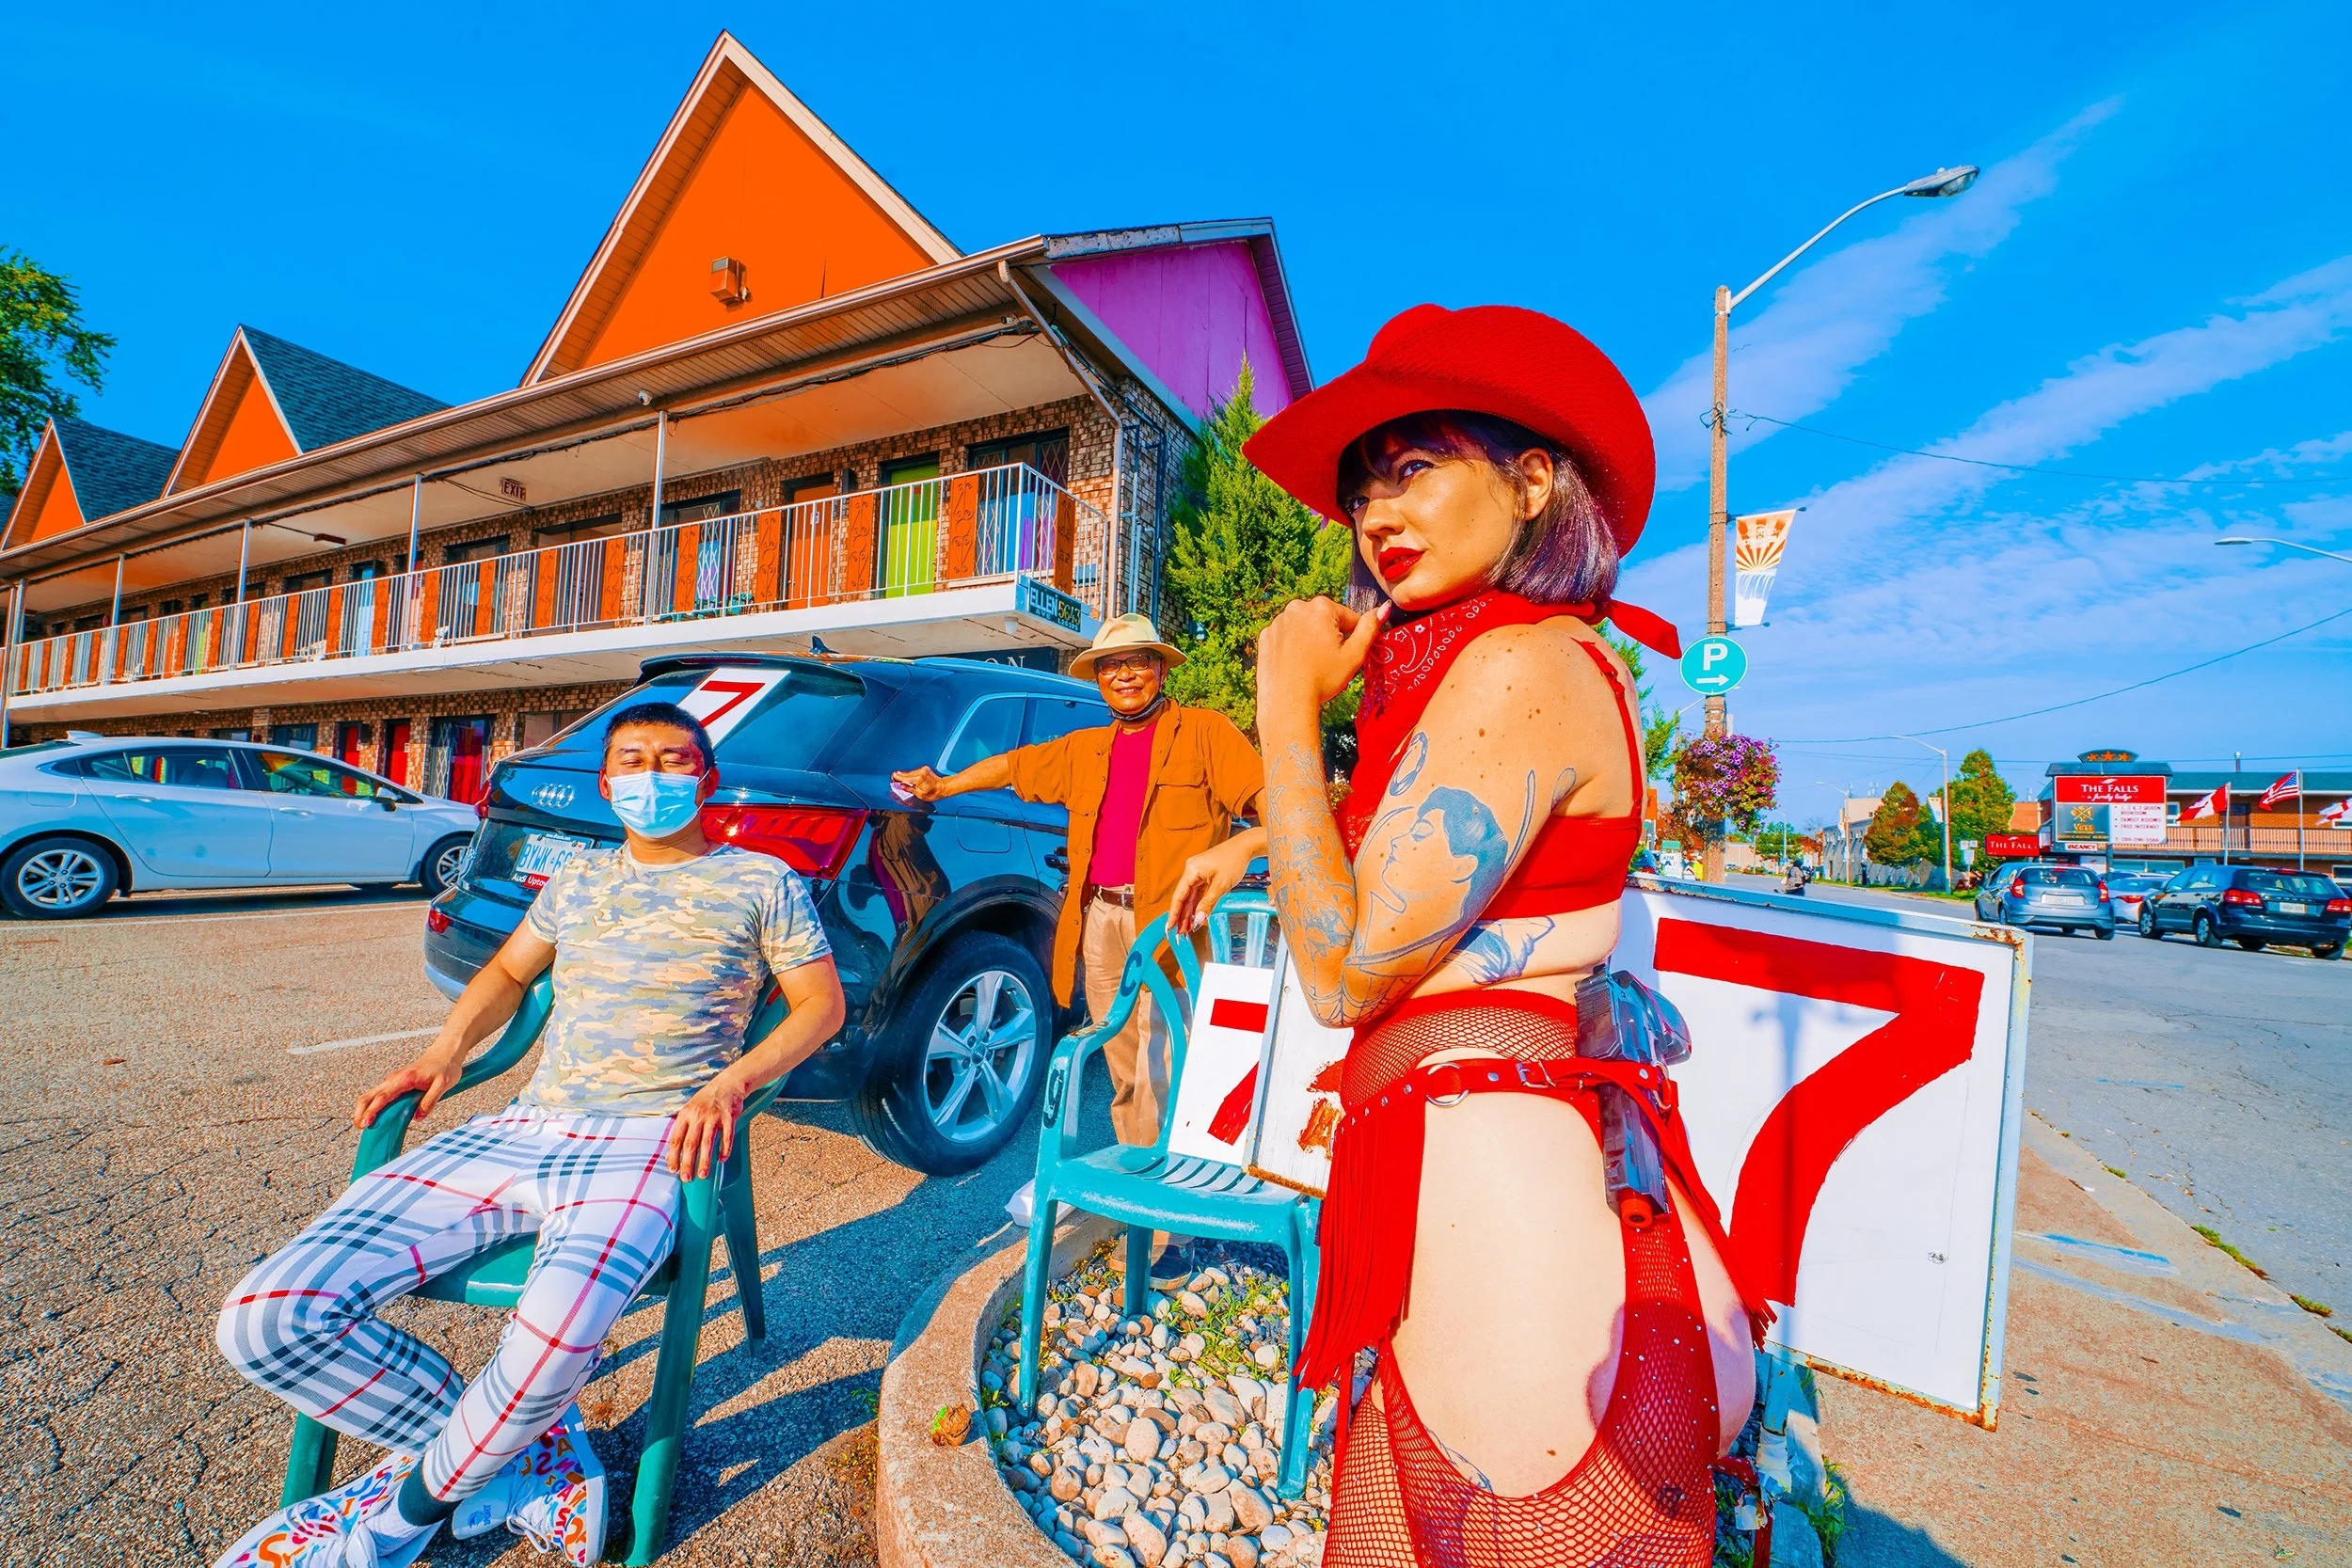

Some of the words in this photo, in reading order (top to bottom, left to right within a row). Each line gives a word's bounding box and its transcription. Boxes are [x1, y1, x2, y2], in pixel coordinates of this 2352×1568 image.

[504, 481, 525, 499] EXIT
[1030, 587, 1058, 617] ELLEN
[1058, 600, 1081, 626] 5643
[1035, 609, 1051, 620] AVE
[1703, 643, 1728, 671] P
[700, 680, 766, 728] 7
[2081, 784, 2103, 793] THE
[2107, 784, 2139, 793] FALLS
[516, 843, 553, 873] BYWK
[512, 873, 528, 882] Audi
[1653, 917, 1985, 1306] 7
[483, 1505, 491, 1525] SPORT
